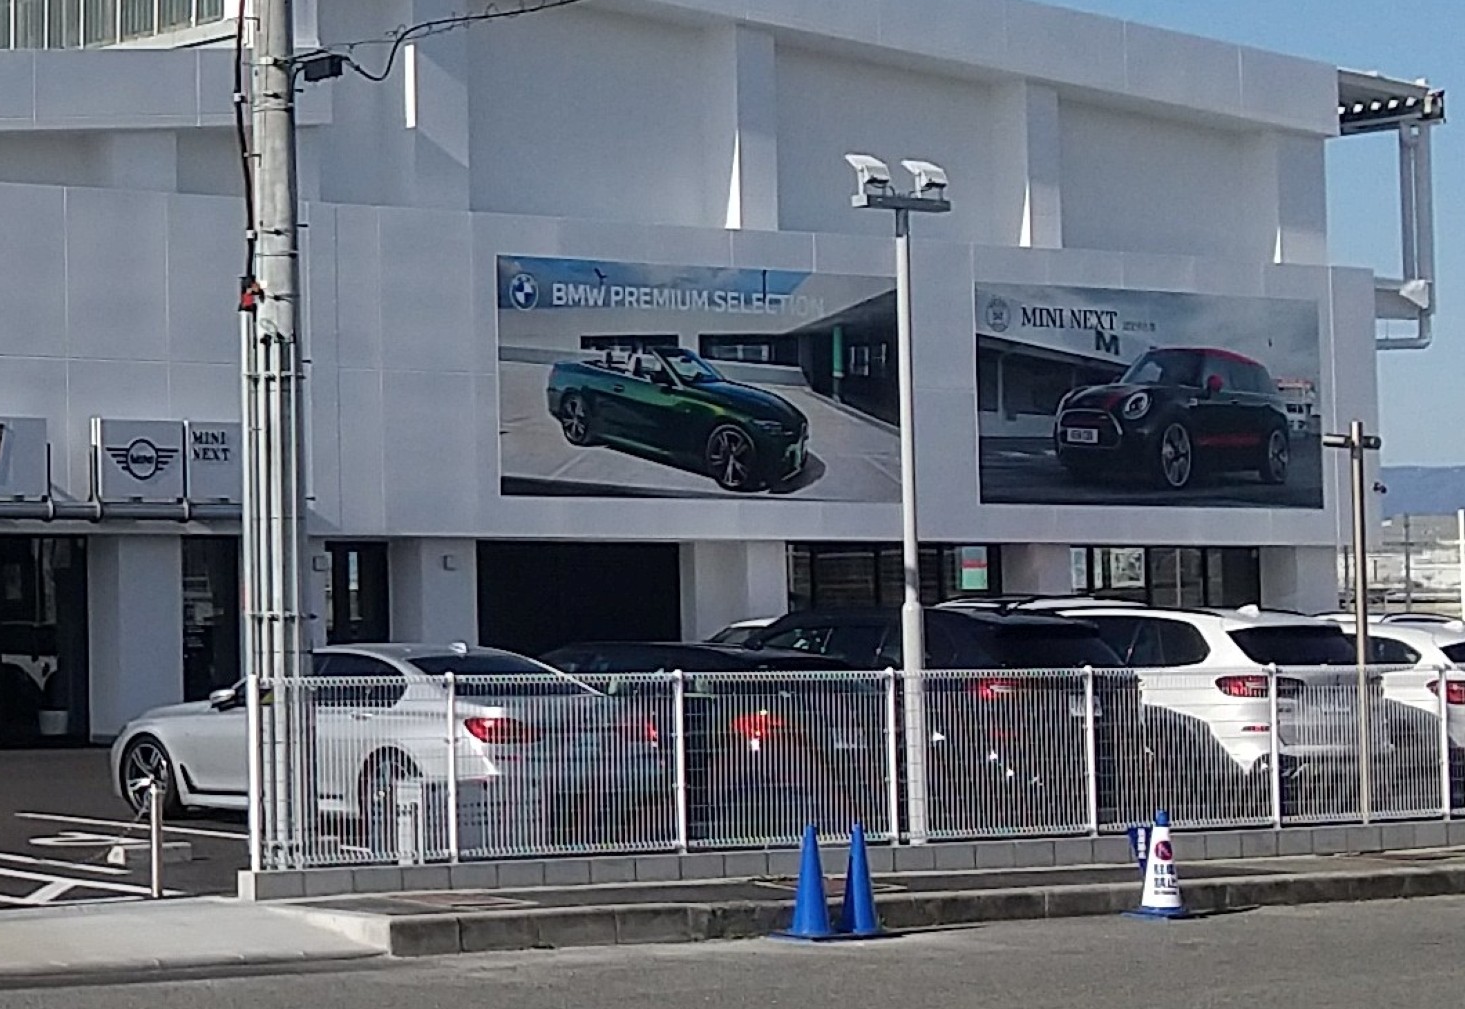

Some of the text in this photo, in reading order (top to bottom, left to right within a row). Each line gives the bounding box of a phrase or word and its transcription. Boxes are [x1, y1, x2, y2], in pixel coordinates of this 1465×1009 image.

[552, 283, 825, 316] BMW PREMIUM SELECTION
[1021, 306, 1064, 328] MINI
[1070, 309, 1118, 331] NEXT
[192, 431, 227, 445] MINI
[193, 447, 231, 461] NEXT
